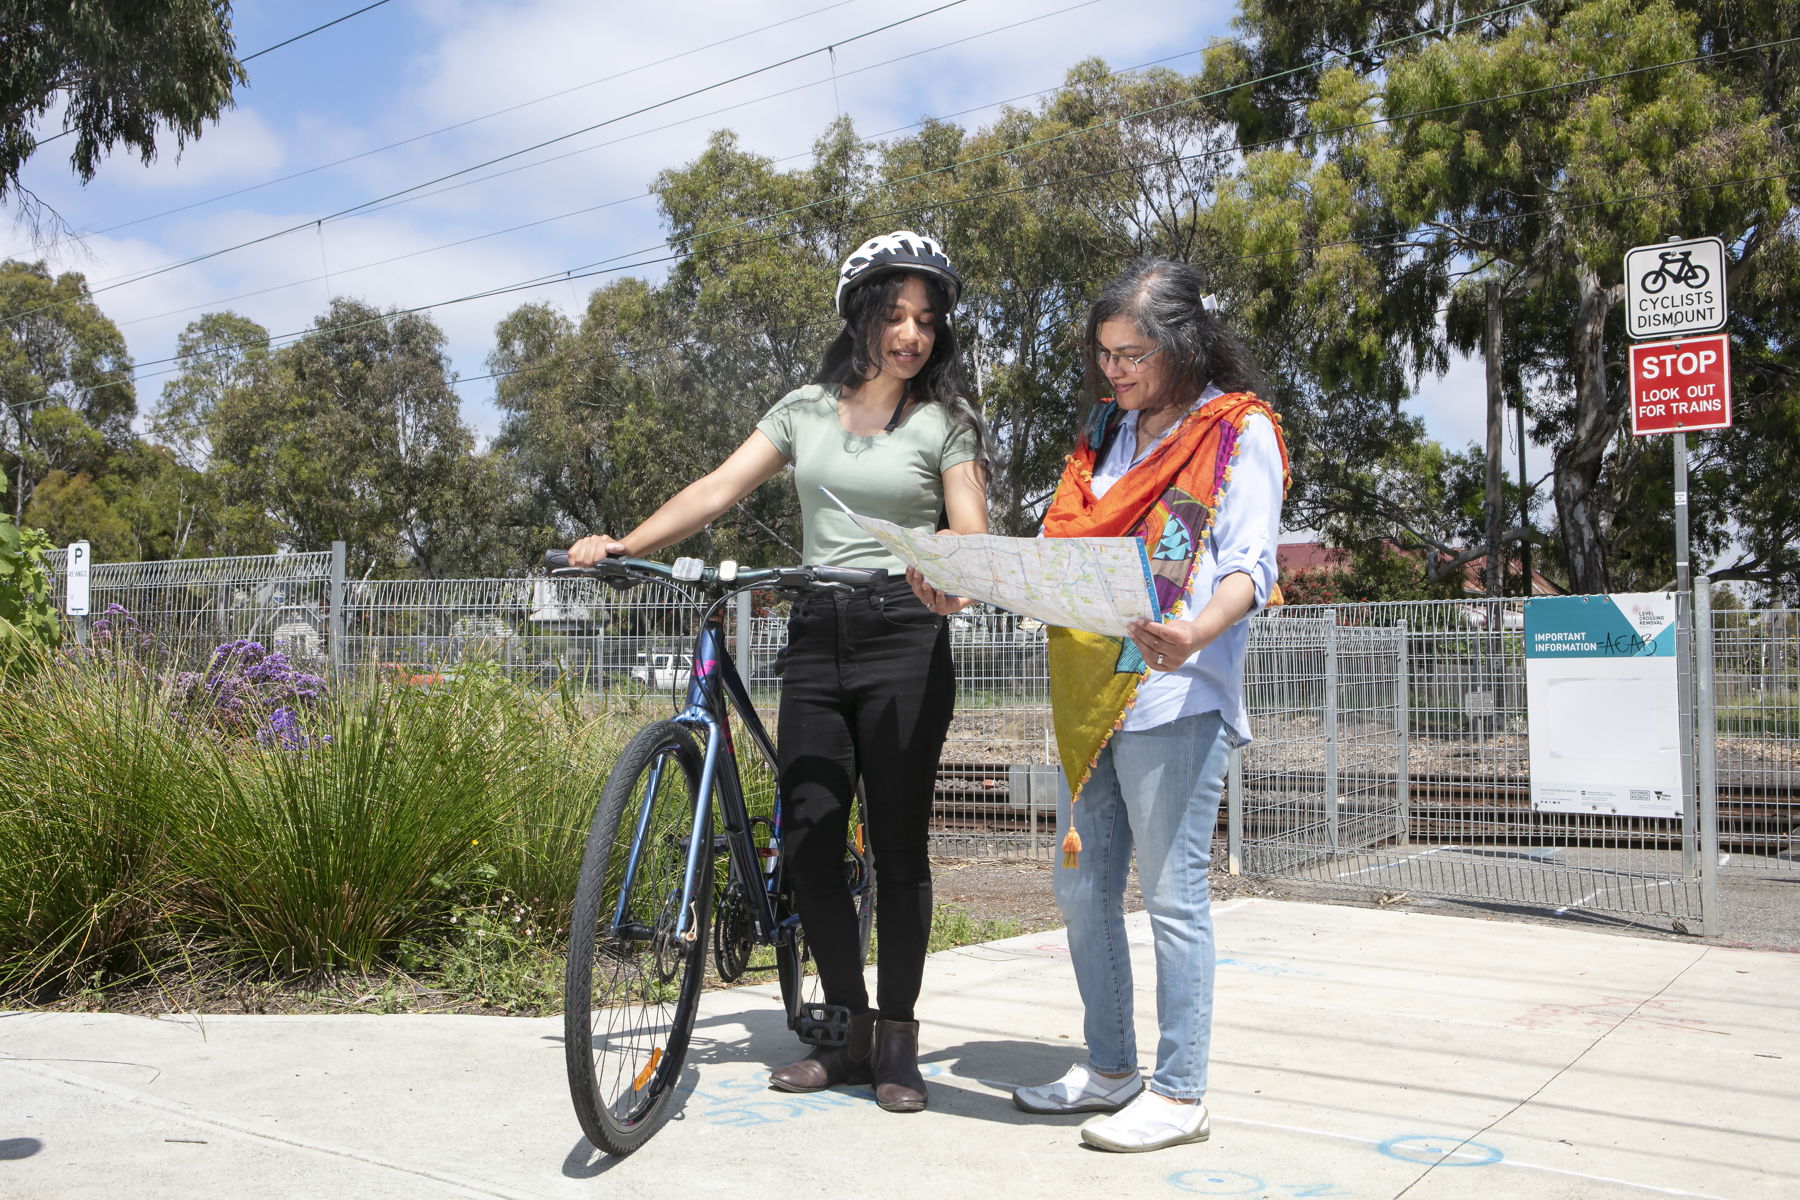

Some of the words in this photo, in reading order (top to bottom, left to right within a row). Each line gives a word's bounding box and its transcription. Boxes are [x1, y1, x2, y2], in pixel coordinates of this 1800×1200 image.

[1639, 291, 1713, 312] CYCLISTS
[1638, 307, 1715, 328] DISMOUNT
[1642, 350, 1717, 379] STOP
[1642, 387, 1680, 403] LOOK
[1687, 384, 1715, 398] OUT
[1639, 404, 1666, 418] FOR
[1670, 398, 1721, 415] TRAINS
[75, 548, 83, 564] P
[1535, 632, 1586, 642] IMPORTANT
[1535, 642, 1597, 652] INFORMATION
